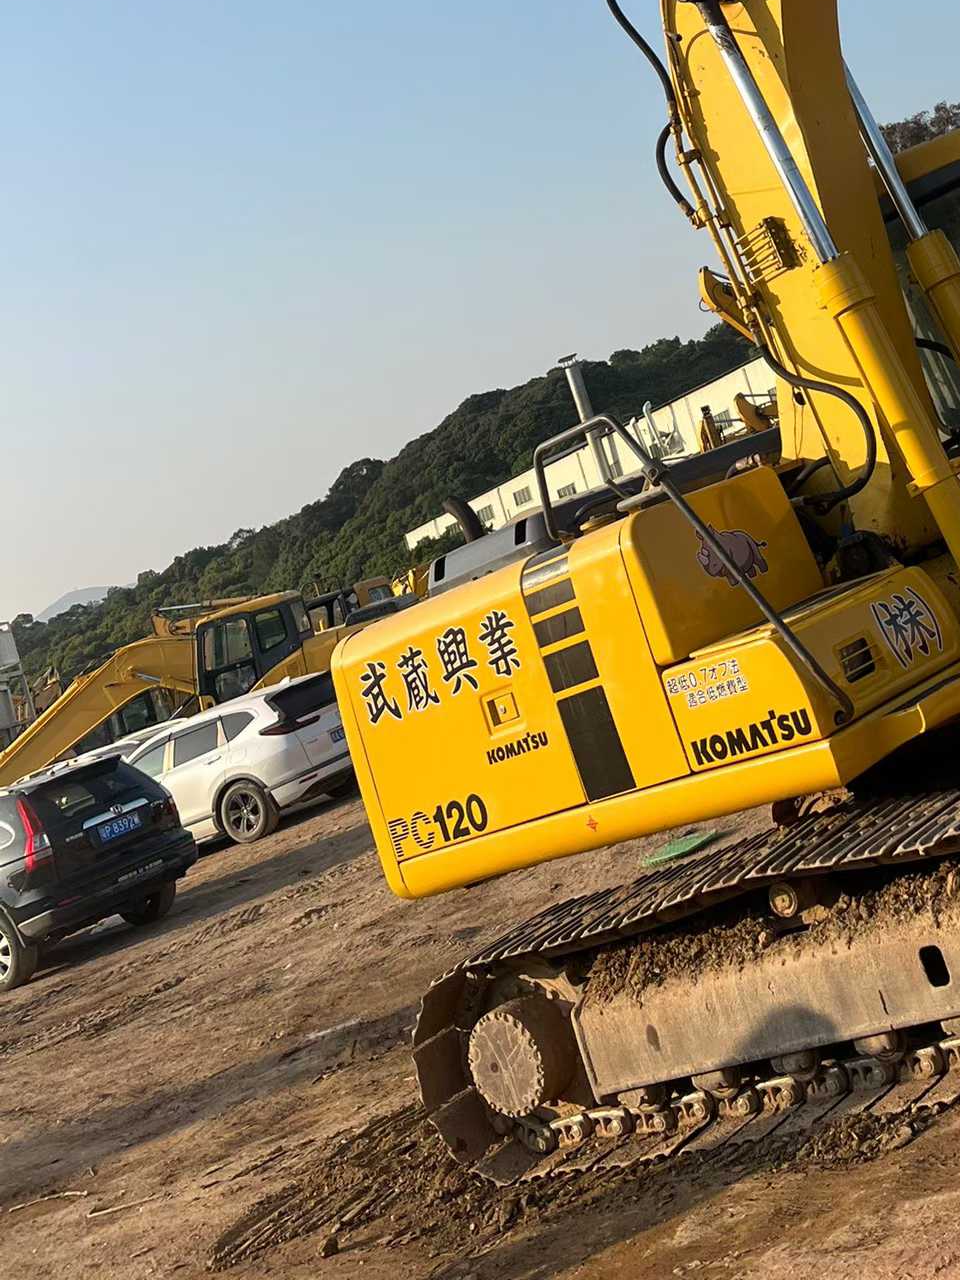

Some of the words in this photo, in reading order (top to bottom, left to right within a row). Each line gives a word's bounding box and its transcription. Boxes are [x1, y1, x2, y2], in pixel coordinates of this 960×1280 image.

[486, 731, 549, 765] KOMATSU
[691, 708, 813, 766] KOMATSU
[388, 793, 488, 858] PC120
